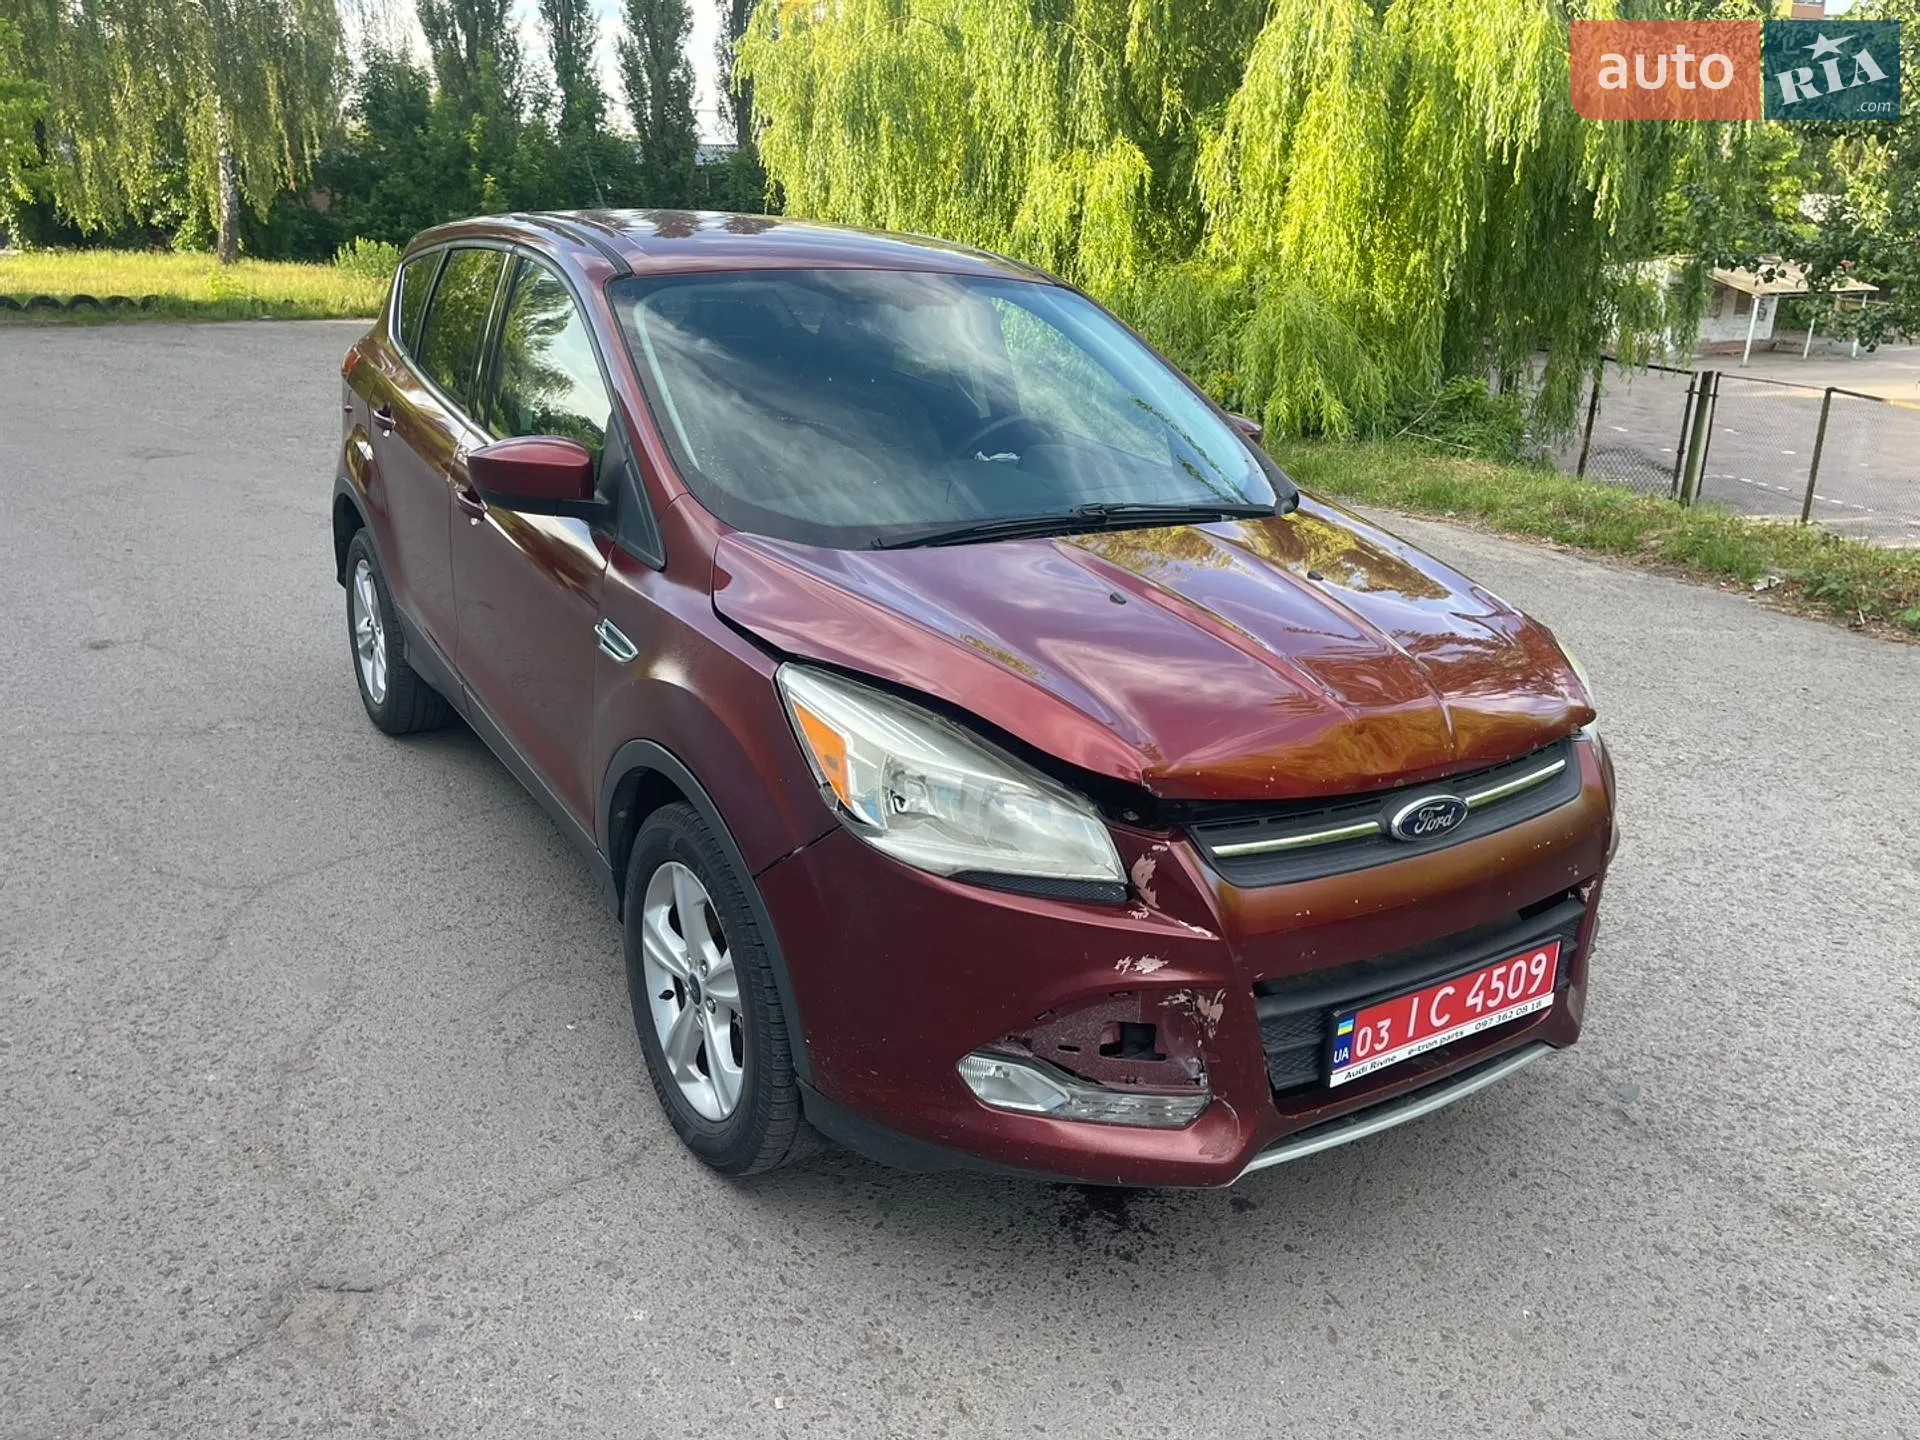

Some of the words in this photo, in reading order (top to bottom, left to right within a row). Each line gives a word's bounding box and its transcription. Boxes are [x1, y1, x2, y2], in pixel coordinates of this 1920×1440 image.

[1414, 804, 1456, 834] Ford
[1356, 1018, 1391, 1057] 03
[1465, 952, 1547, 1013] 4509
[1333, 1047, 1349, 1064] UA
[1344, 1064, 1368, 1081] Audi
[1369, 1054, 1397, 1070] Rivne
[1407, 1039, 1438, 1055] e-tron
[1439, 1029, 1464, 1046] parts
[1474, 1016, 1494, 1031] 097
